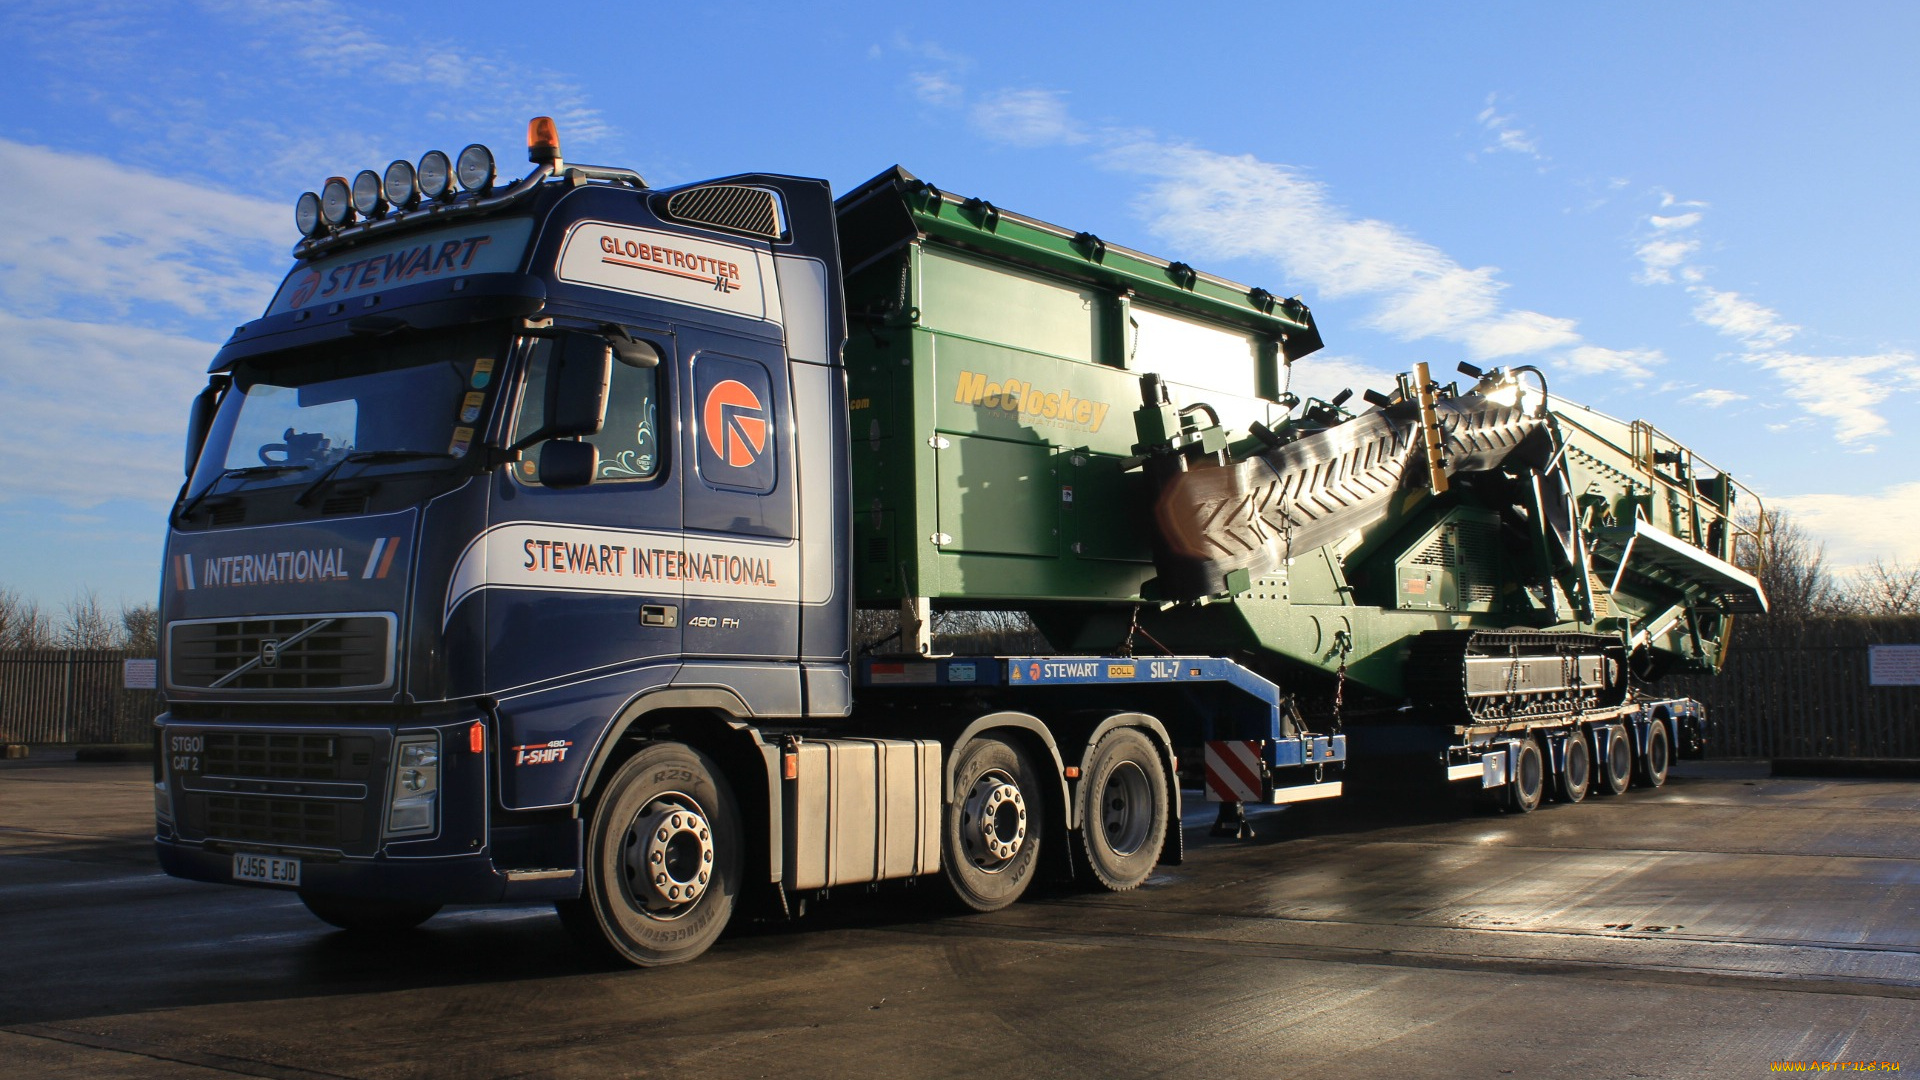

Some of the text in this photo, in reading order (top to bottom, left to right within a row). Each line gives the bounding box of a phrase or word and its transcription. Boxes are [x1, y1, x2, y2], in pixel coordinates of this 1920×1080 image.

[321, 235, 493, 298] STEWART
[600, 235, 740, 280] GLOBETROTTER
[714, 276, 731, 294] XL
[954, 370, 1110, 434] McCloskey
[988, 411, 1089, 433] INTERNATIONAL
[204, 547, 349, 589] INTERNATIONAL
[524, 538, 777, 587] STEWART INTERNATIONAL
[688, 616, 740, 629] 480 FH
[1044, 662, 1099, 678] STEWART
[1110, 667, 1132, 676] DOLL
[1150, 661, 1180, 679] SIL-7
[174, 755, 199, 771] CAT 2
[236, 856, 296, 881] YJ56 EJD
